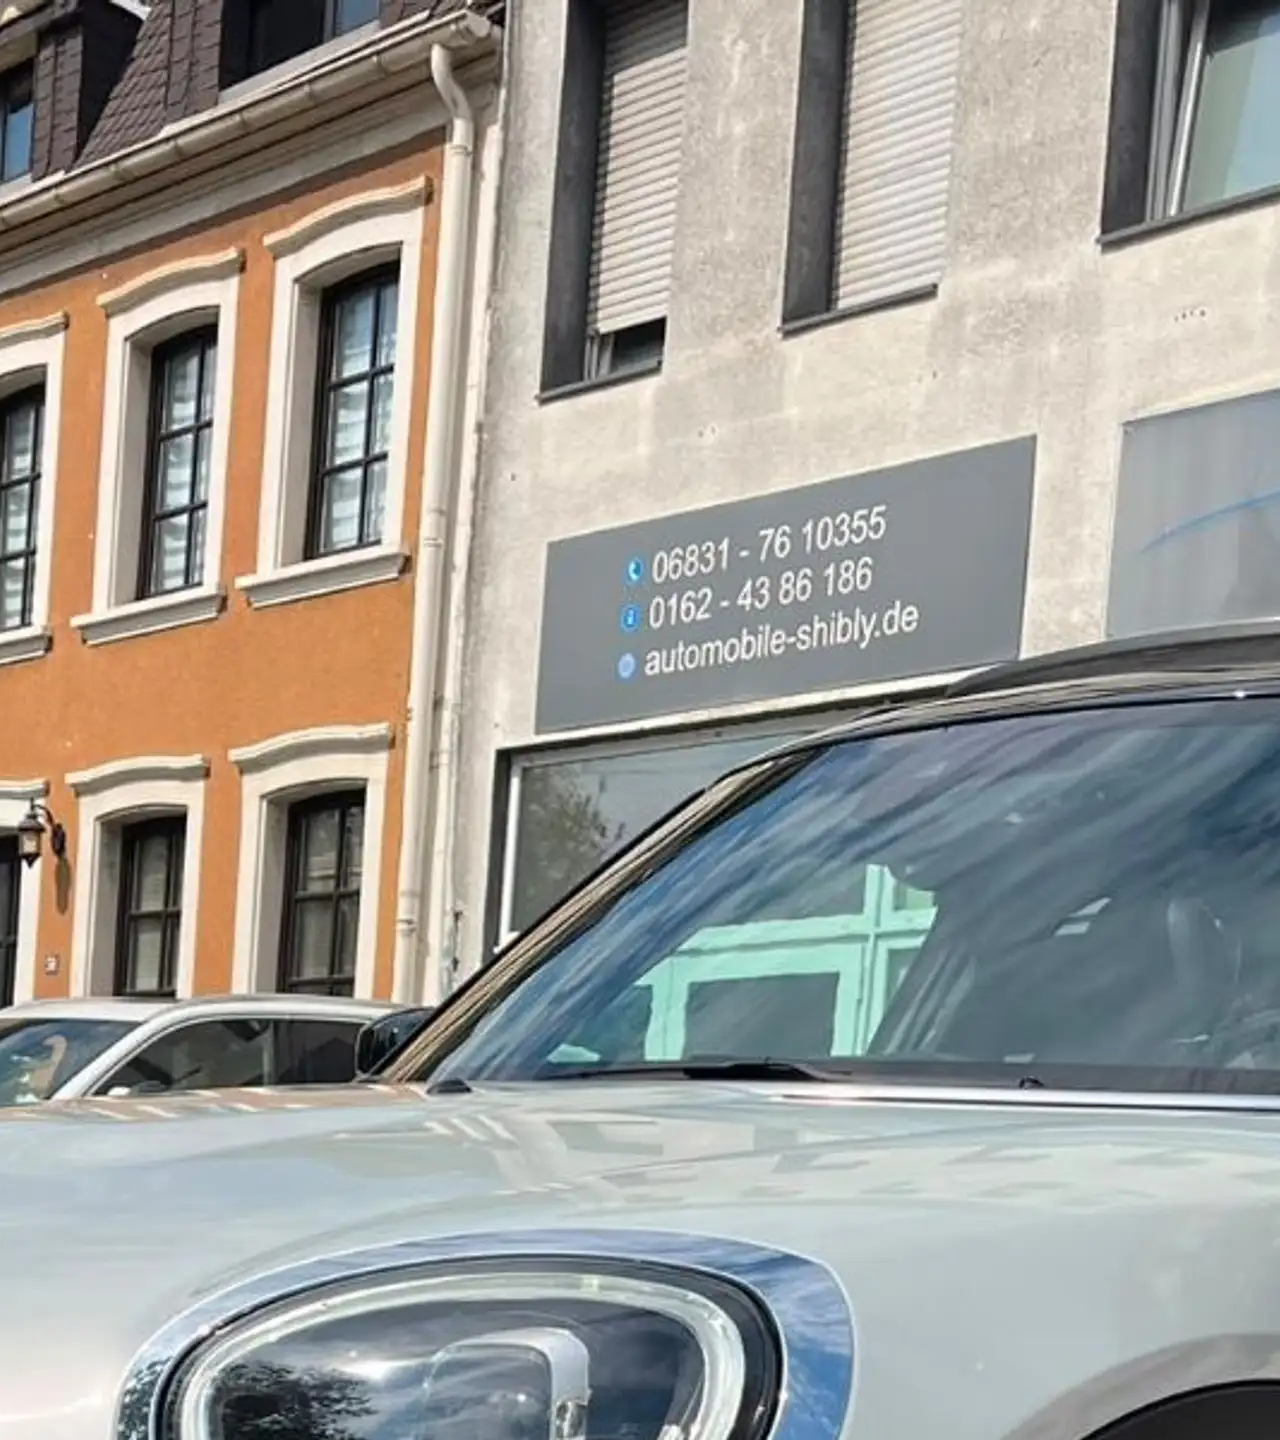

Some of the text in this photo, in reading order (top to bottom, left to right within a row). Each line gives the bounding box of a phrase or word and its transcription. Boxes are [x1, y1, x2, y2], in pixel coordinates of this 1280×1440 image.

[651, 538, 730, 585] 06831
[758, 526, 792, 565] 76
[802, 505, 888, 555] 10355
[649, 588, 712, 630] 0162
[736, 573, 771, 612] 43
[779, 567, 812, 605] 86
[823, 556, 873, 598] 186
[644, 600, 920, 677] automobile-shibly.de
